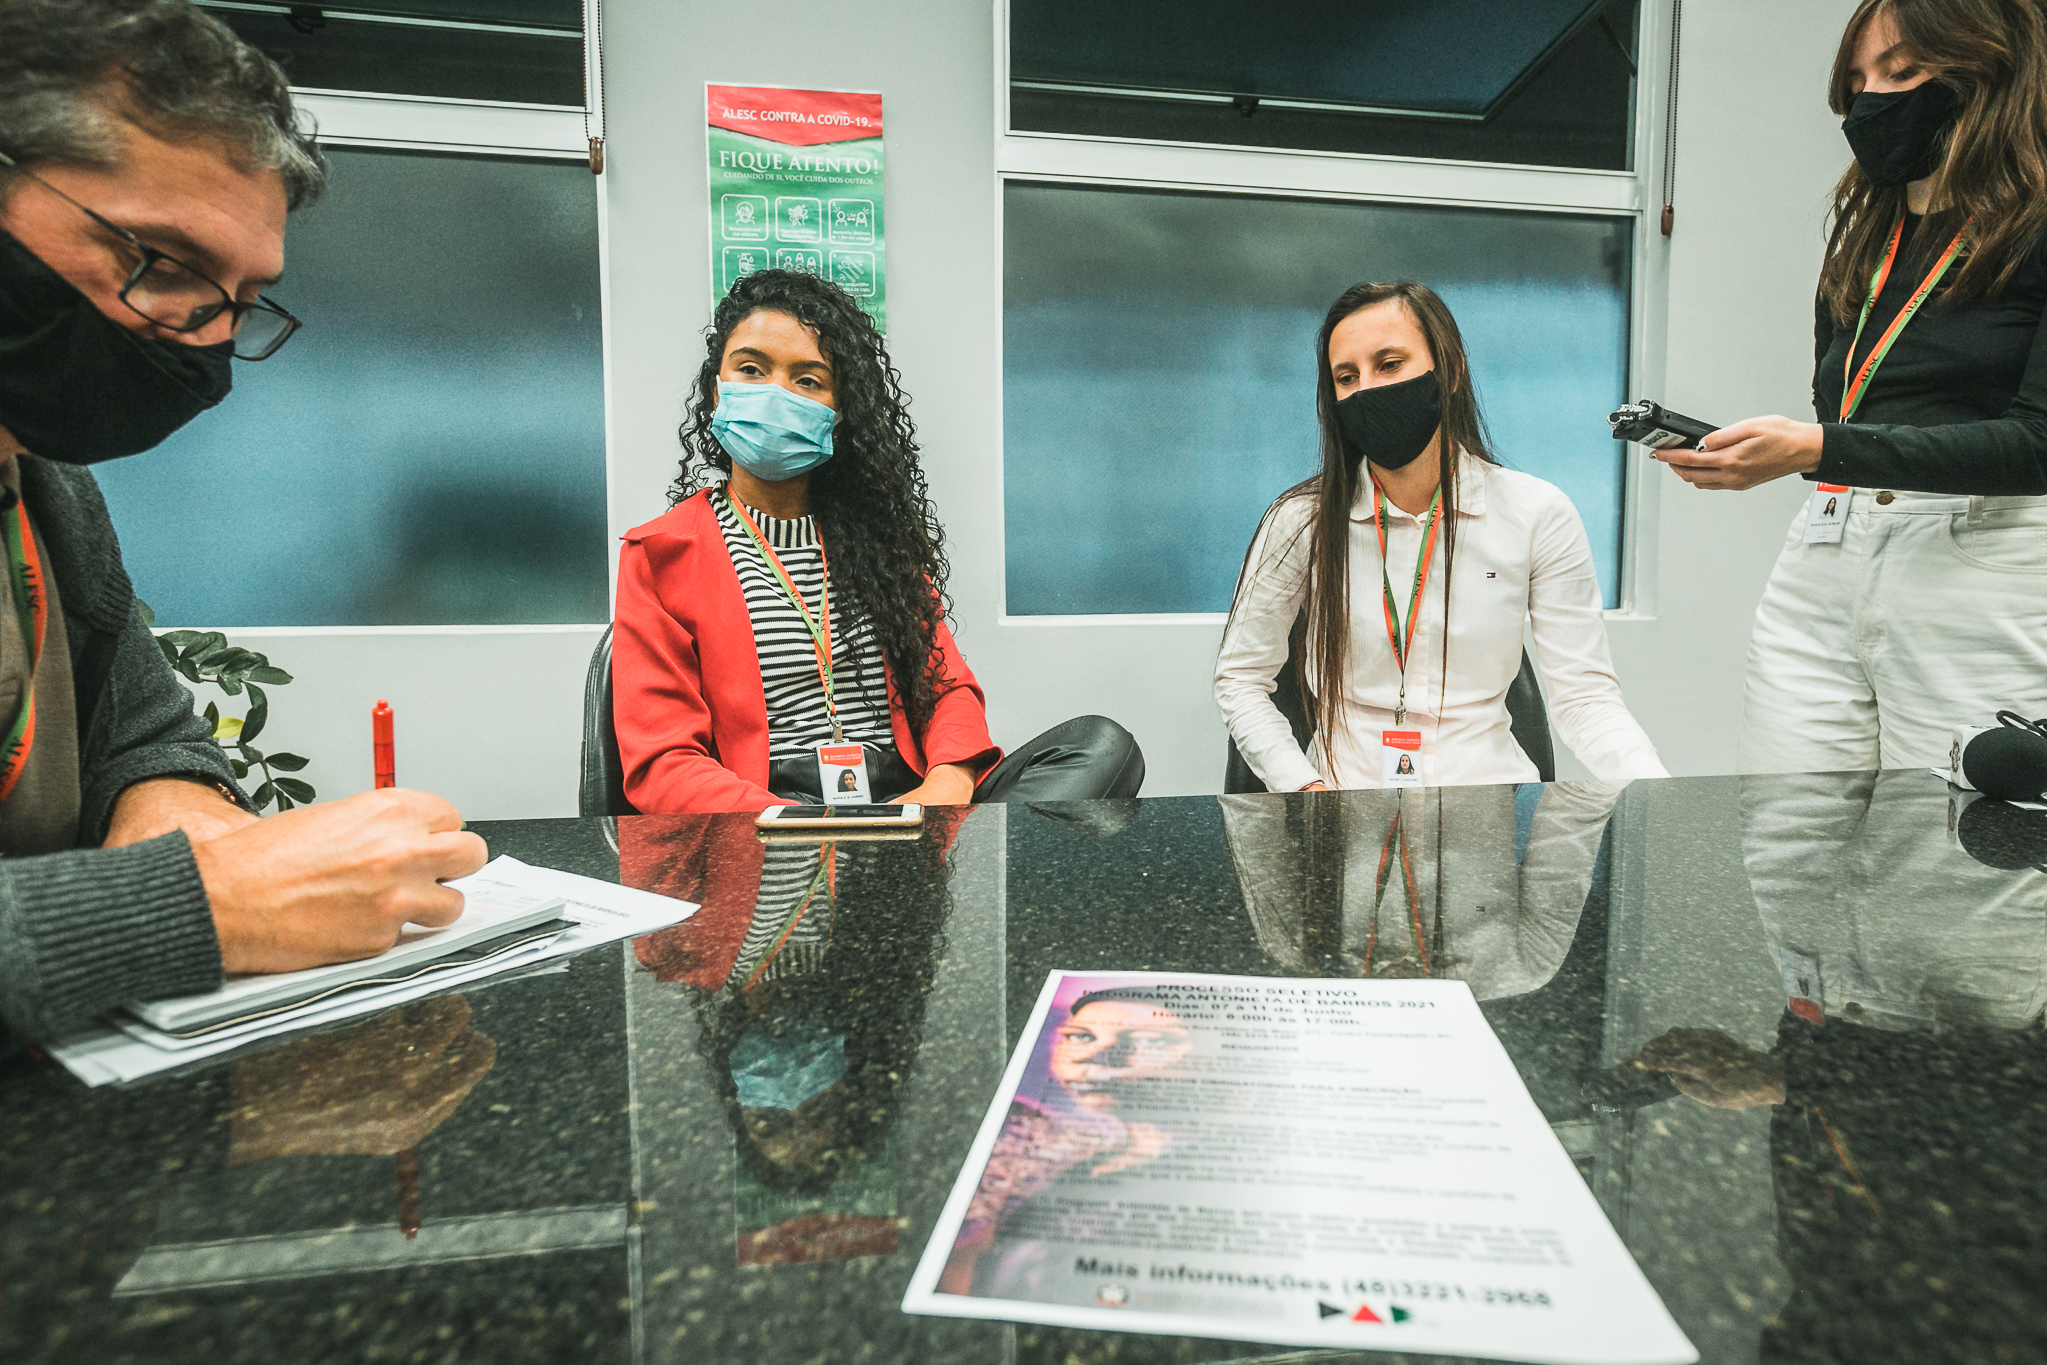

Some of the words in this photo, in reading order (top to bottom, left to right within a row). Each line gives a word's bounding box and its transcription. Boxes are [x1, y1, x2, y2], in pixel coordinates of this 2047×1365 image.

[722, 108, 757, 121] ALESC
[760, 110, 805, 123] CONTRA
[807, 113, 815, 124] A
[817, 114, 872, 127] COVID-19.
[719, 150, 783, 173] FIQUE
[788, 154, 879, 175] ATENTO!
[723, 171, 764, 181] CUIDANDO
[765, 173, 775, 181] DE
[784, 173, 804, 182] VOCÊ
[805, 175, 828, 183] CUIDA
[829, 176, 844, 184] DOS
[844, 177, 875, 185] OUTROS.
[1904, 287, 1930, 317] ALESC
[1860, 354, 1881, 385] ALESC
[1377, 503, 1386, 531] ALESC
[1427, 503, 1439, 531] ALESC
[18, 562, 41, 615] ALESC
[1413, 571, 1423, 599] ALESC
[1082, 989, 1181, 1001] PROGRAMA
[1184, 992, 1283, 1004] ANTONIETA
[1287, 998, 1312, 1006] DE
[1317, 999, 1393, 1009] BARROS
[1398, 1000, 1437, 1010] 2021
[1155, 984, 1260, 994] PROCESSO
[1265, 987, 1359, 998] SELETIVO
[1211, 1002, 1229, 1011] 07
[1273, 1006, 1293, 1014] de
[1299, 1007, 1353, 1016] Junho
[1073, 1255, 1139, 1280] Mais
[1148, 1263, 1331, 1293] informações
